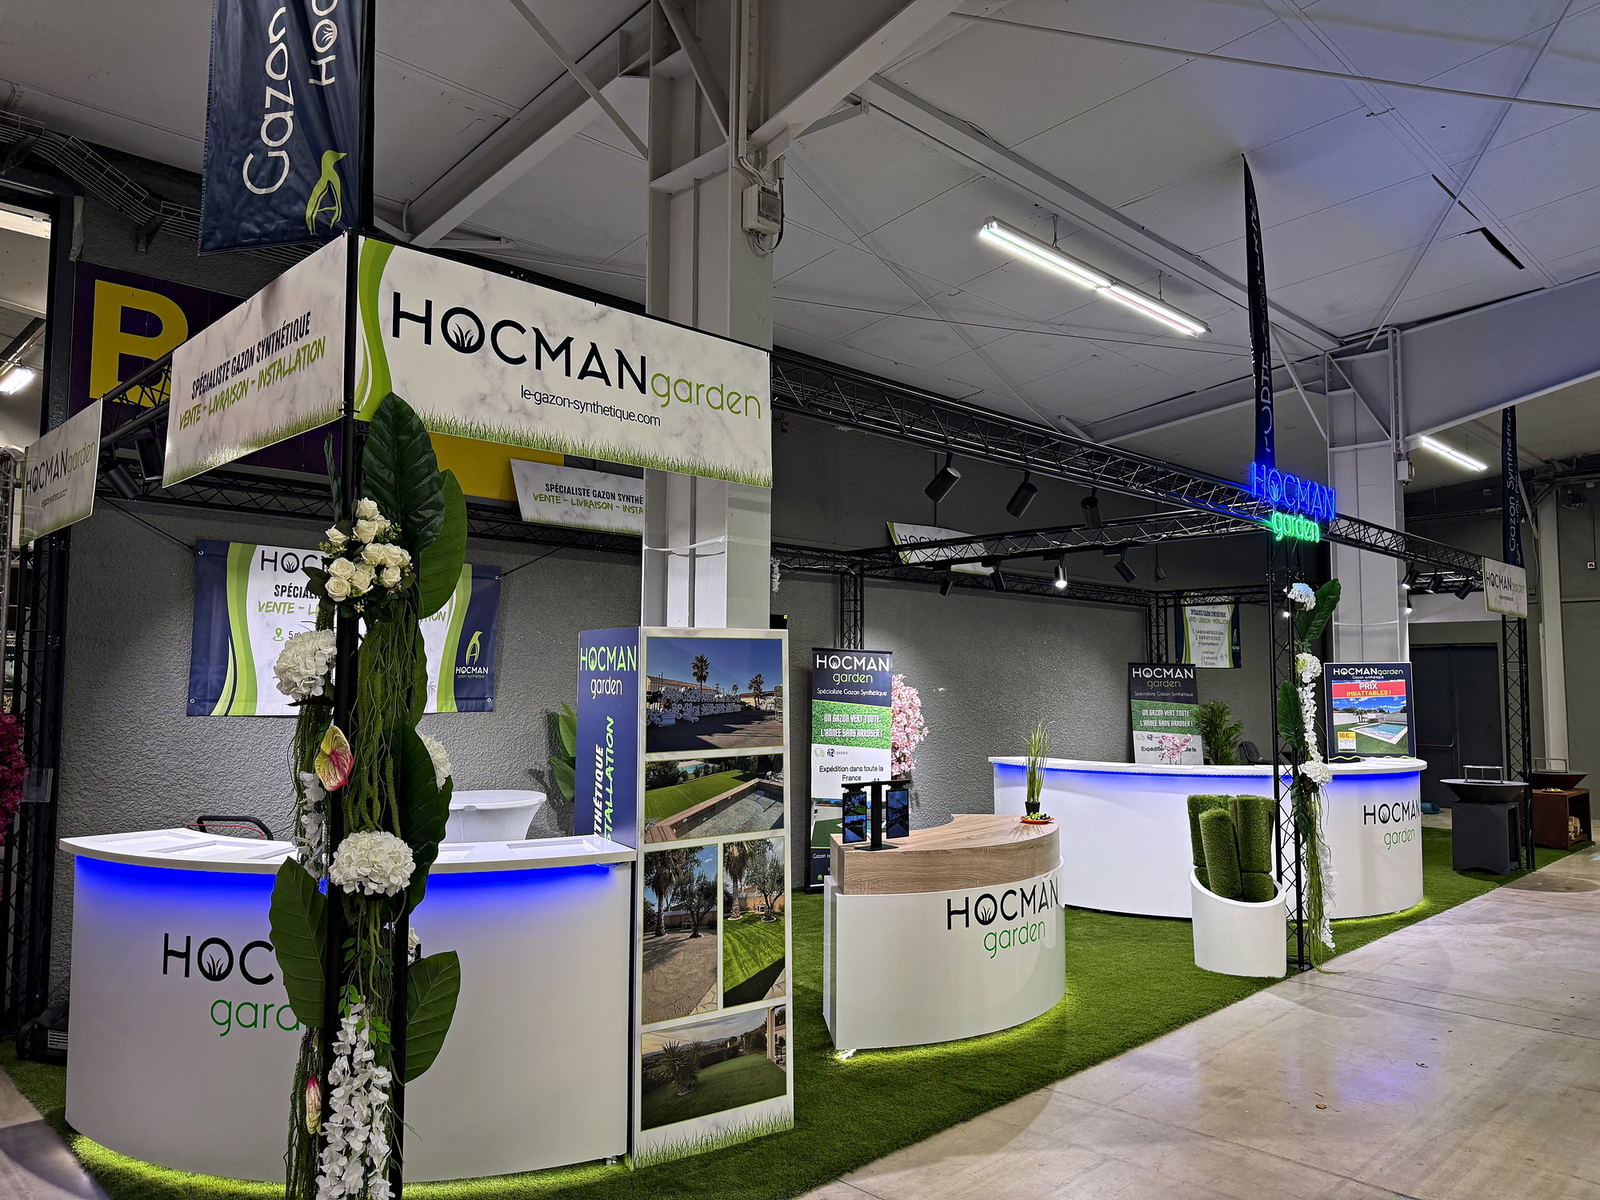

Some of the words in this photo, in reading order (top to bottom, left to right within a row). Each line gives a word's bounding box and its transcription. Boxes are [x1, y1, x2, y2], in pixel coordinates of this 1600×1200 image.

[191, 357, 231, 400] SPÉCIALISTE
[231, 345, 255, 377] GAZON
[256, 311, 311, 363] SYNTHÉTIQUE
[179, 403, 202, 431] VENTE
[208, 378, 250, 414] LIVRAISON
[257, 336, 326, 392] INSTALLATION
[520, 384, 661, 428] le-gazon-synthetique.com
[532, 492, 562, 504] VENTE
[571, 498, 613, 511] LIVRAISON
[545, 482, 591, 498] SPÉCIALISTE
[592, 490, 616, 501] GAZON
[1251, 461, 1336, 522] HOCMAN
[1272, 510, 1320, 543] garden
[261, 550, 325, 574] HOC
[257, 600, 295, 615] VENTE
[580, 645, 637, 671] HOCMAN
[816, 654, 890, 671] HOCMAN
[456, 666, 489, 674] HOCMAN
[832, 672, 874, 686] garden
[1132, 667, 1194, 679] HOCMAN
[590, 676, 623, 699] garden
[843, 688, 860, 696] Gazon
[1146, 679, 1181, 689] garden
[1359, 682, 1378, 690] PRIX
[819, 765, 849, 774] Expédition
[863, 765, 878, 773] toute
[841, 774, 862, 782] France
[593, 744, 604, 838] THÉTIQUE
[1363, 798, 1420, 825] HOCMAN
[1383, 828, 1416, 850] garden
[946, 876, 1059, 930] HOCMAN
[983, 921, 1046, 959] garden
